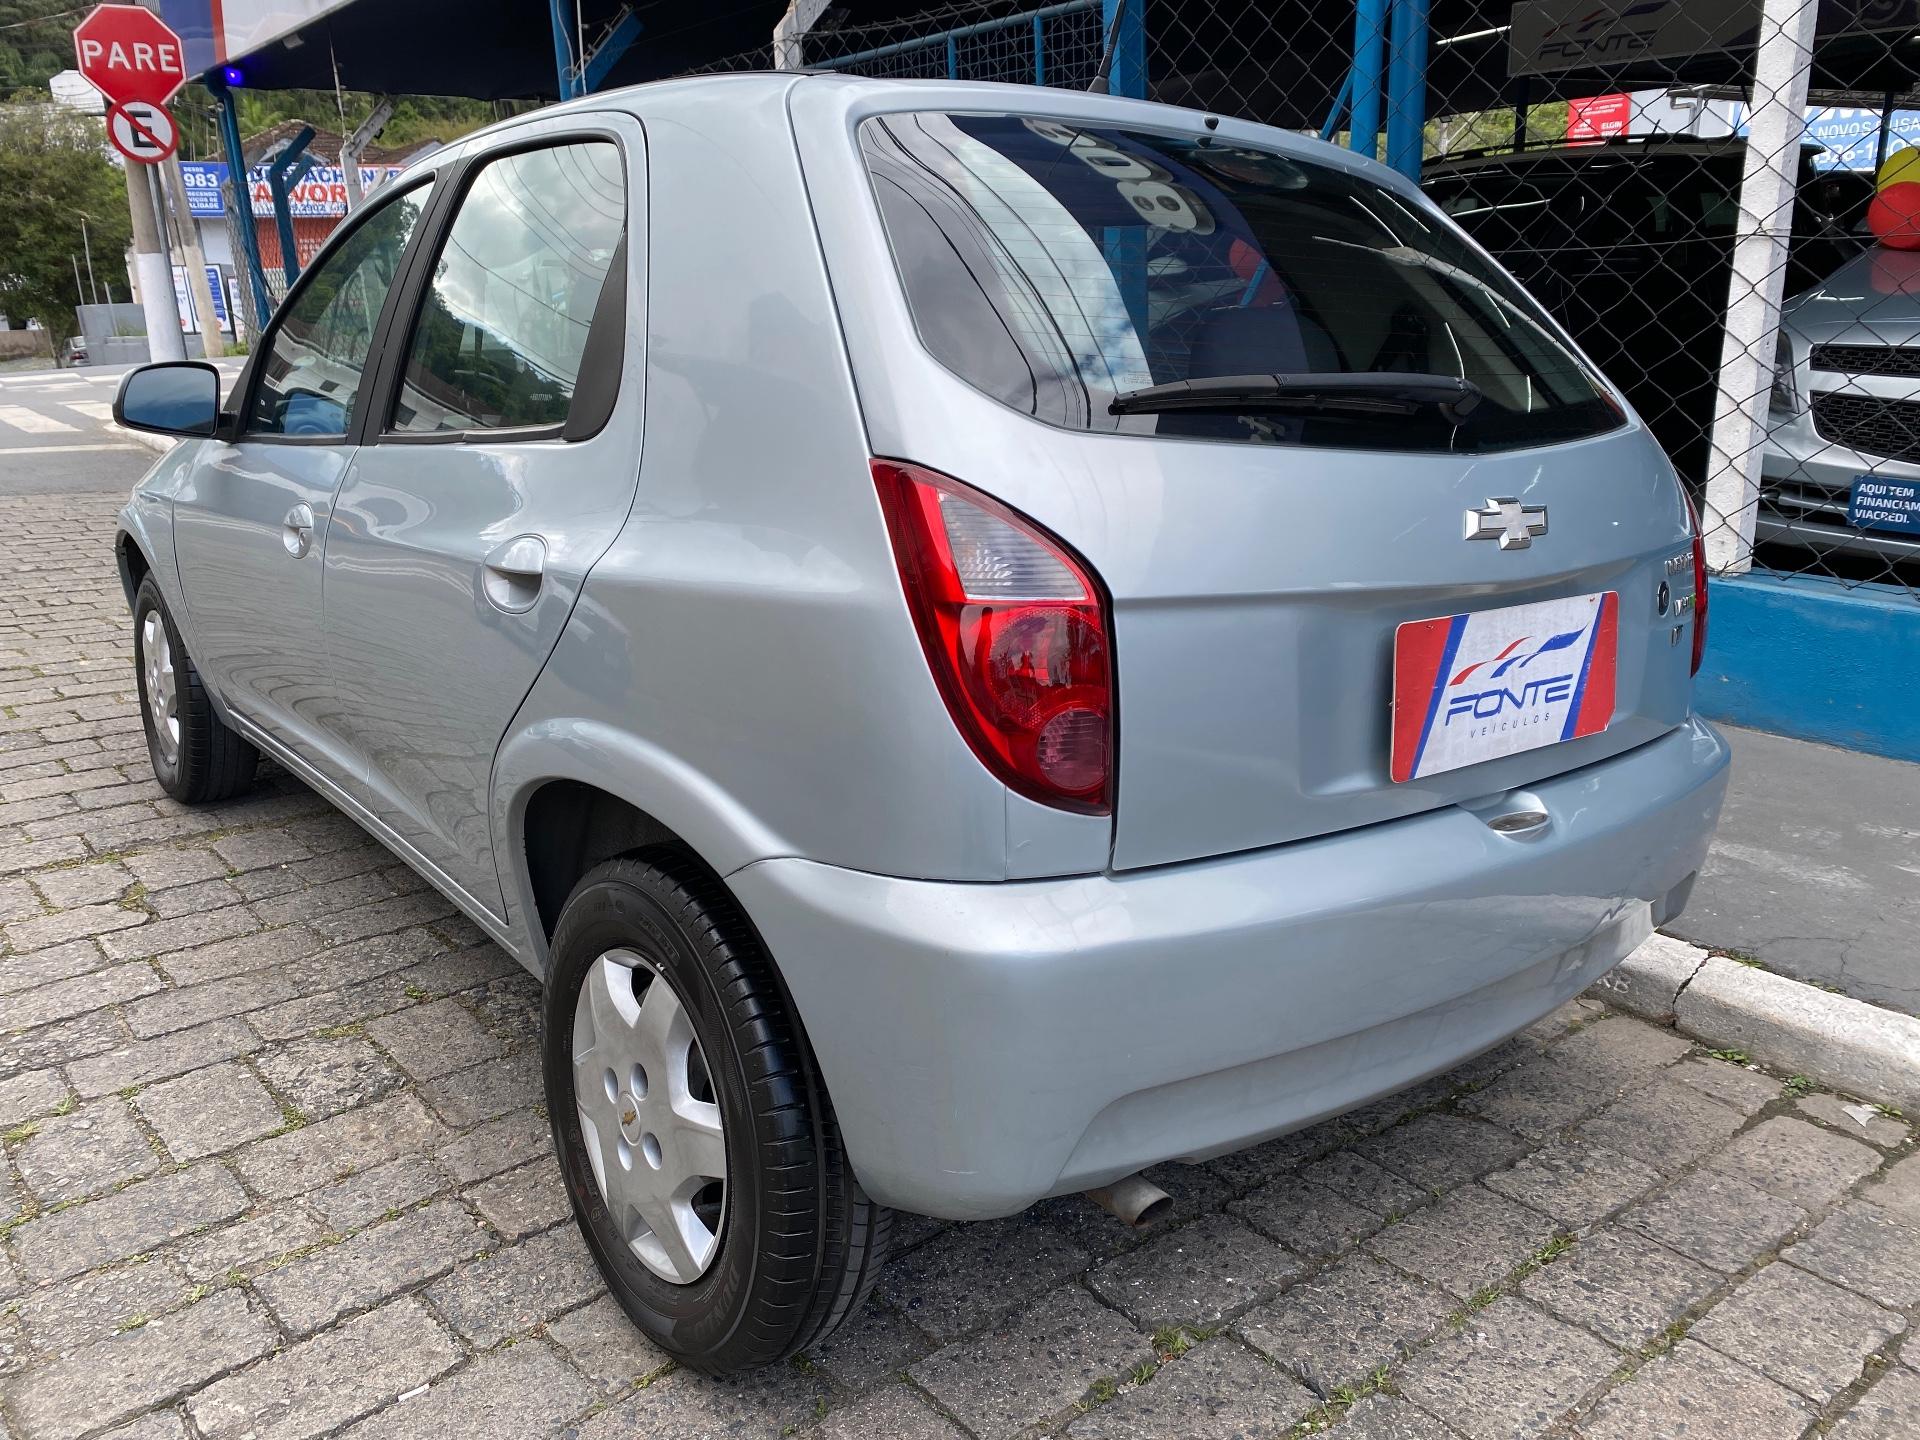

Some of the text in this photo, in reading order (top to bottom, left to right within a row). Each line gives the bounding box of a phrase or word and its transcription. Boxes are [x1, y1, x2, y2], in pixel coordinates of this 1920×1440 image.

[81, 39, 180, 72] PARE
[1601, 120, 1623, 130] ELGIN
[1818, 121, 1871, 139] NOVOS
[183, 172, 219, 188] 983
[1858, 483, 1915, 498] AQUI TEM
[1856, 496, 1920, 512] FINANCIAM
[1445, 674, 1574, 726] FONTE
